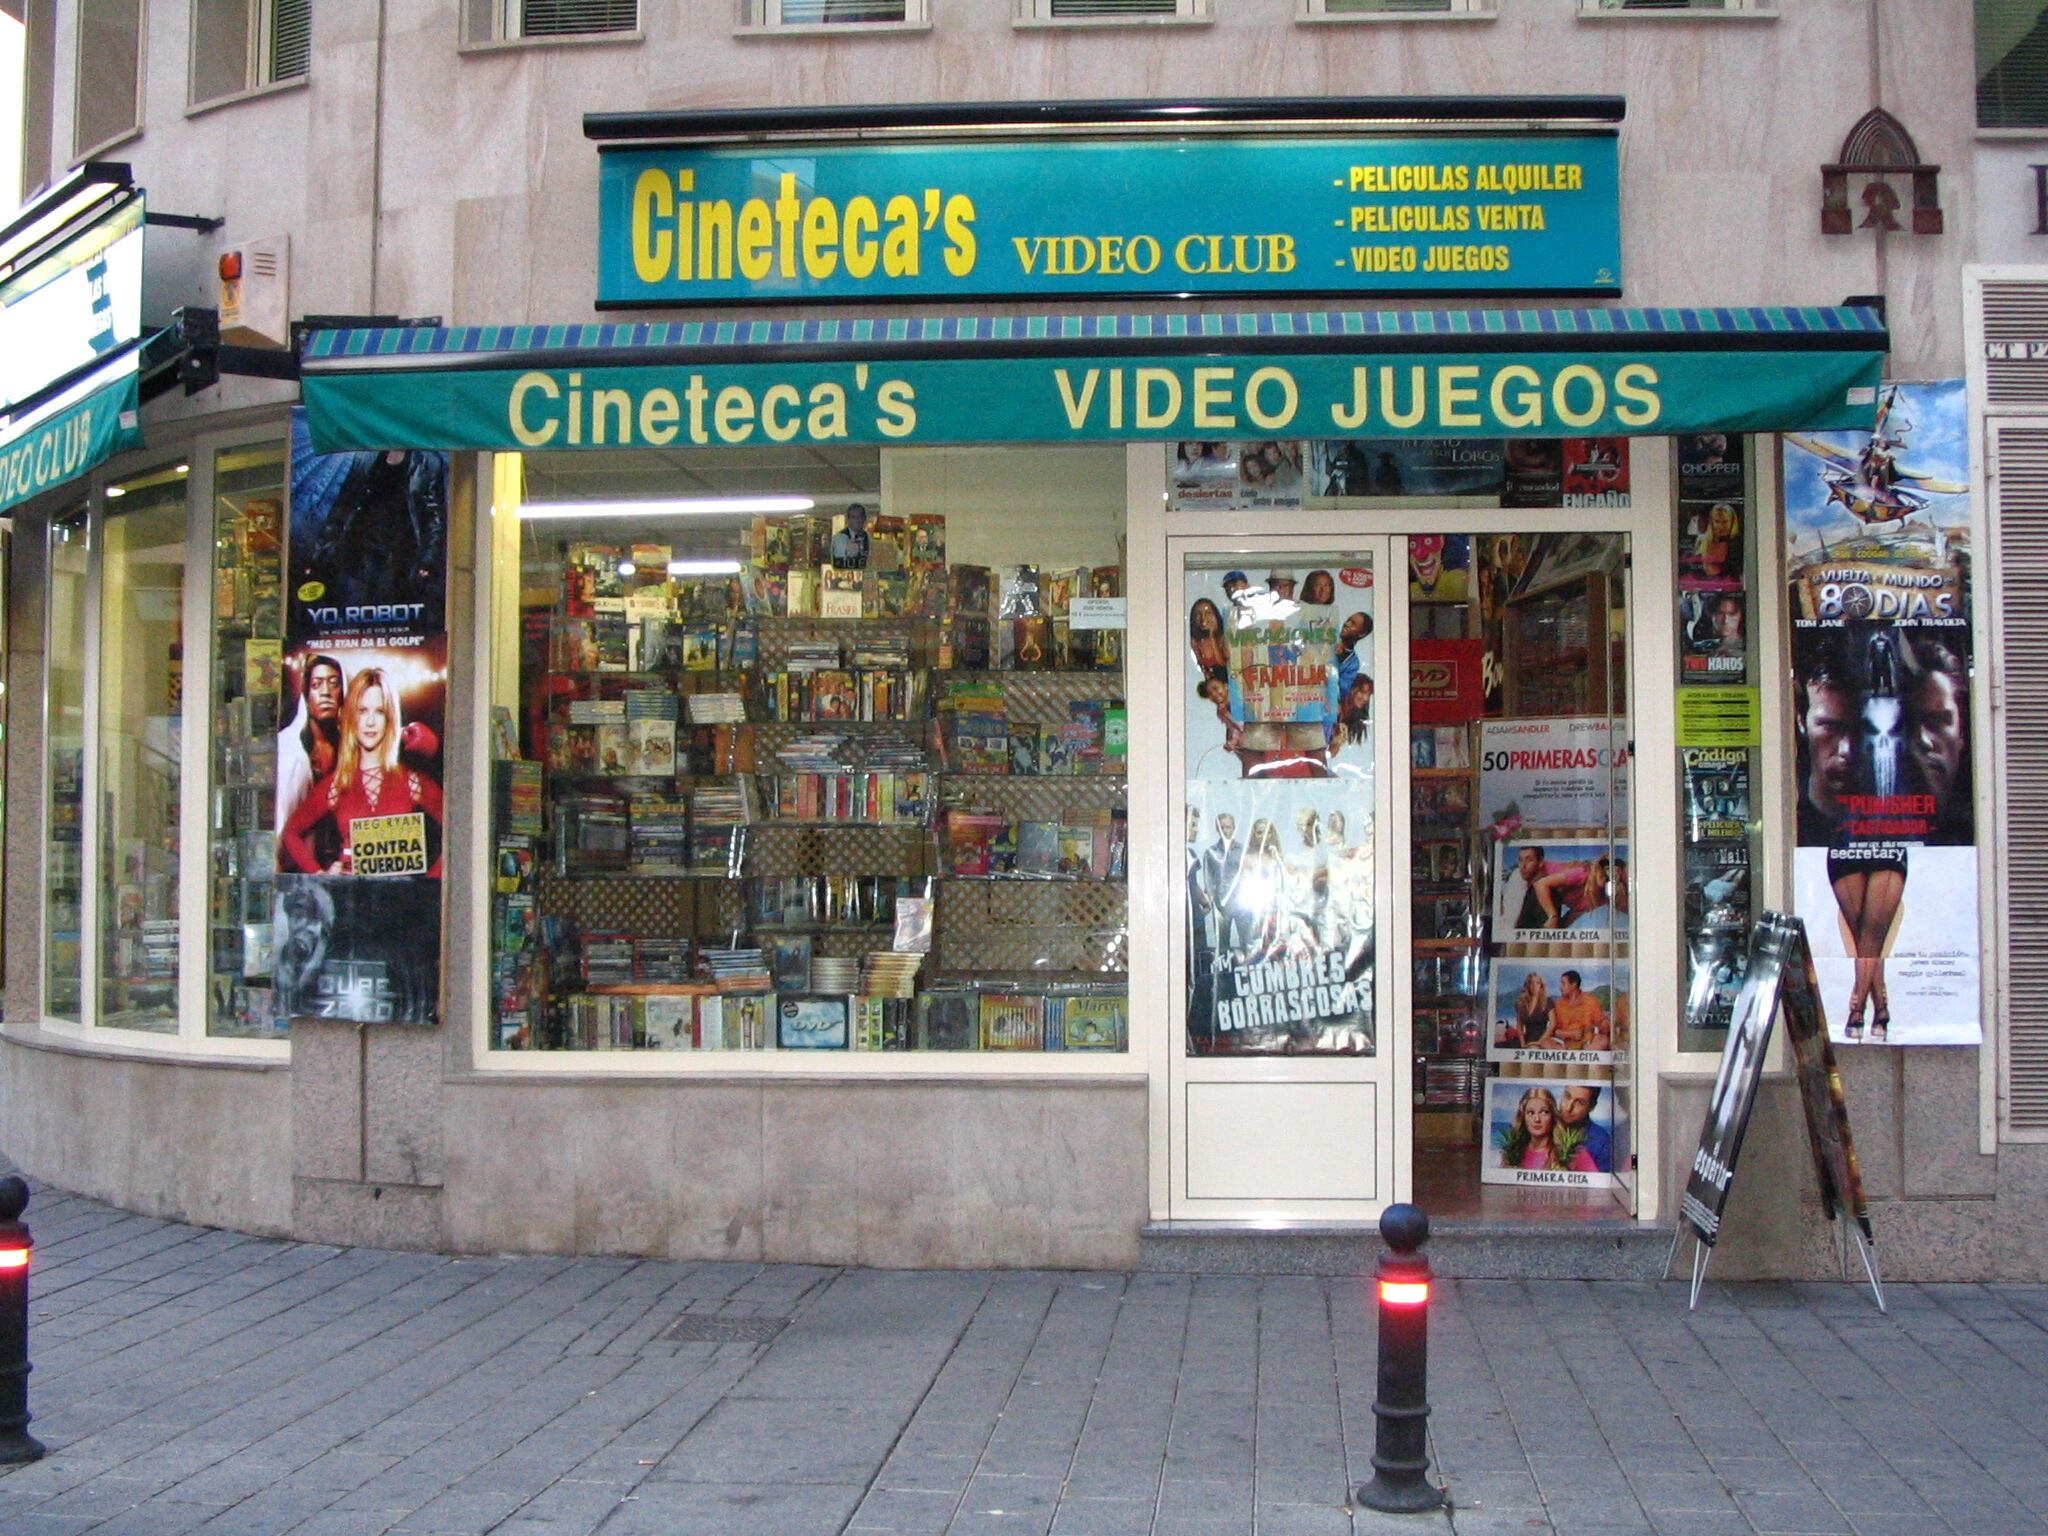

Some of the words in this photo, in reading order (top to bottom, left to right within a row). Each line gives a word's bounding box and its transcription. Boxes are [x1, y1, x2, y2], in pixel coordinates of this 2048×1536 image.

[1350, 166, 1469, 192] PELICULAS
[1476, 165, 1582, 195] ALQUILER
[632, 167, 976, 283] Cineteca's
[1012, 235, 1161, 275] VIDEO
[1175, 234, 1296, 274] CLUB
[1351, 206, 1470, 232] PELICULAS
[1476, 205, 1545, 230] VENTA
[1351, 247, 1416, 272] VIDEO
[1423, 246, 1509, 271] JUEGOS
[508, 364, 917, 447] Cineteca's
[1054, 367, 1299, 430] VIDEO
[1330, 364, 1662, 430] JUEGOS
[36, 408, 91, 486] CLUB
[1682, 462, 1740, 474] CHOPPER
[1563, 491, 1630, 509] ENGAÑO
[1821, 569, 1872, 584] VUELTA
[1883, 573, 1943, 589] MUNDO
[345, 603, 425, 622] ROBOT
[1875, 589, 1954, 618] DIAS
[1795, 618, 1818, 628] TOM
[1819, 618, 1846, 628] JANE
[1892, 618, 1918, 628] JOHN
[1921, 618, 1967, 627] TRAVOLTA
[334, 638, 360, 649] RYAN
[361, 637, 375, 648] DA
[376, 636, 387, 647] EL
[1707, 656, 1744, 673] HANDS
[1849, 794, 1937, 815] PUNISHER
[353, 818, 380, 831] MEG
[386, 815, 422, 828] RYAN
[353, 838, 423, 857] CONTRA
[1830, 847, 1905, 862] secretary
[360, 854, 425, 875] CUERDAS
[1529, 928, 1577, 941] PRIMERA
[1579, 928, 1600, 941] CITA
[1234, 951, 1346, 997] CUMBRES
[1217, 978, 1373, 1032] BORRASCOSAS
[1528, 1051, 1577, 1062] PRIMERA
[1579, 1050, 1600, 1062] CITA
[1517, 1172, 1564, 1184] PRIMERA
[1567, 1173, 1589, 1185] CITA
